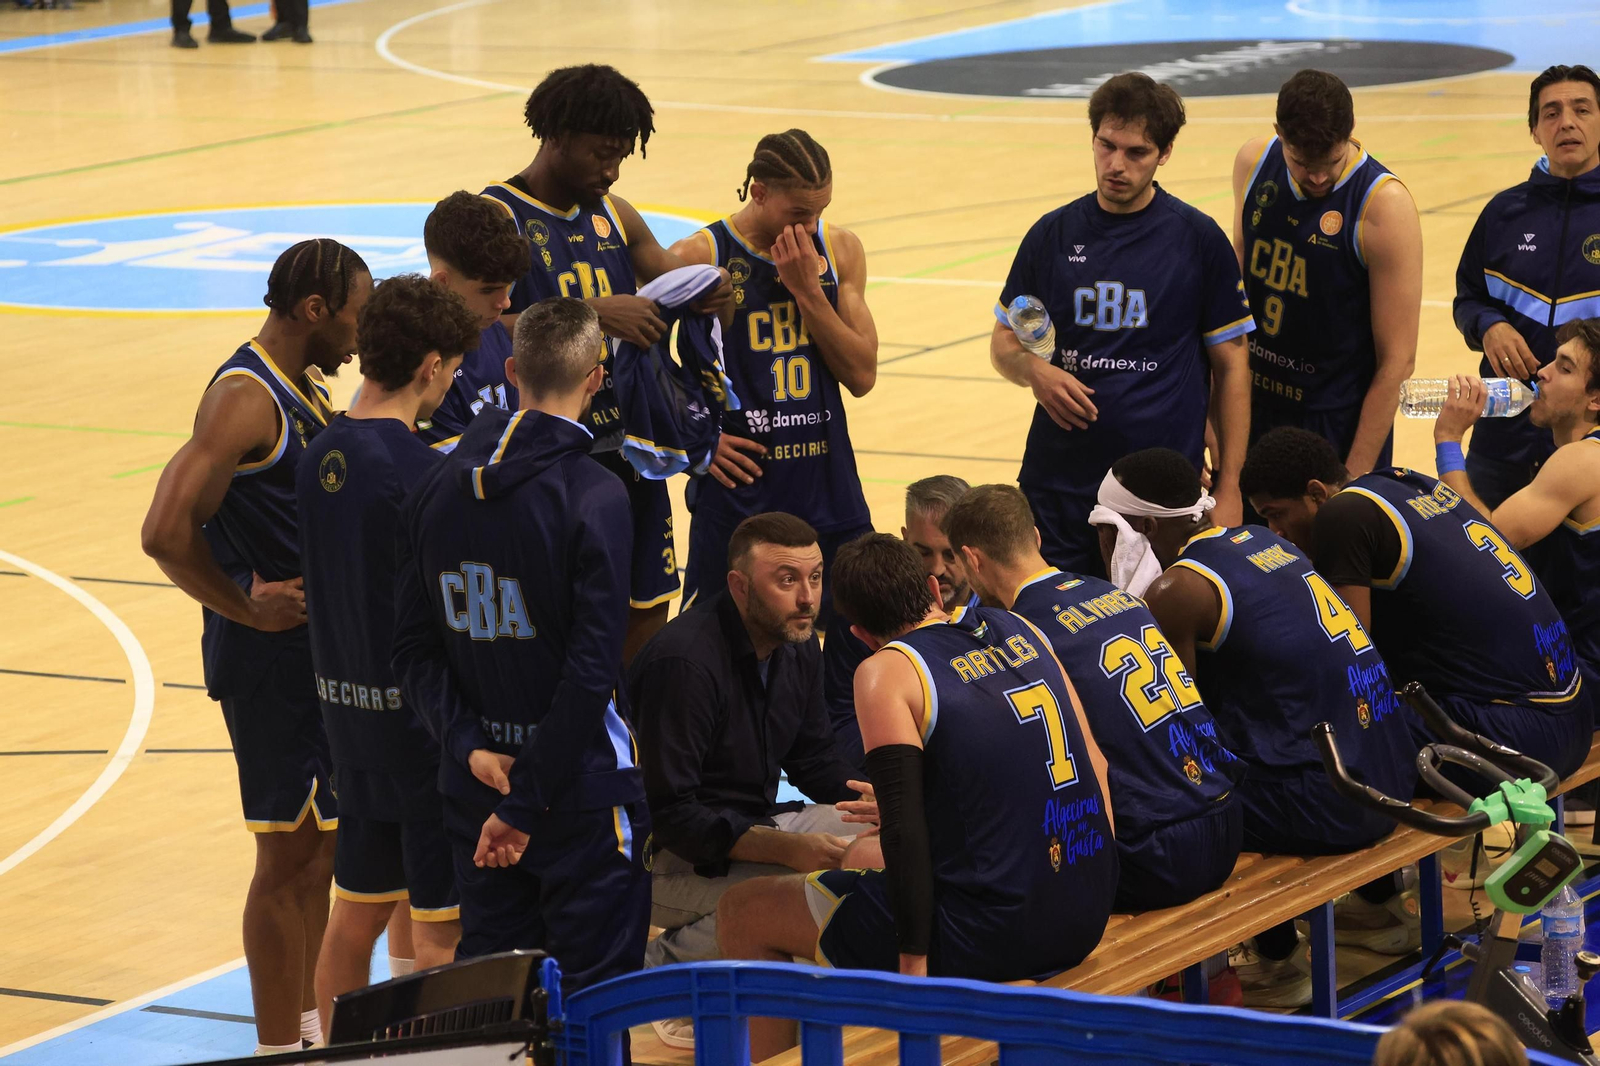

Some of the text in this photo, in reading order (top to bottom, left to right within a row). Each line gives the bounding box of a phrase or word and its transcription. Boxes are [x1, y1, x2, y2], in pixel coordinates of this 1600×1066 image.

[567, 234, 585, 243] vive
[1068, 254, 1087, 263] vive
[1517, 243, 1537, 252] vive
[557, 261, 613, 300] CBA
[1250, 238, 1310, 298] CBA
[1073, 281, 1150, 331] CBA
[1261, 293, 1285, 338] 9
[770, 354, 812, 402] 10
[1249, 338, 1316, 374] damex.io
[1245, 543, 1300, 574] MARK
[1462, 518, 1538, 600] 3
[438, 560, 536, 642] CBA
[1301, 570, 1374, 656] 4
[949, 633, 1040, 684] ARTLES
[1098, 623, 1204, 734] 22
[314, 671, 403, 711] LGECIRAS
[1002, 678, 1080, 791] 7
[1041, 793, 1100, 842] Algeciras
[1066, 827, 1105, 866] Gusta
[1518, 1011, 1553, 1049] cecotec
